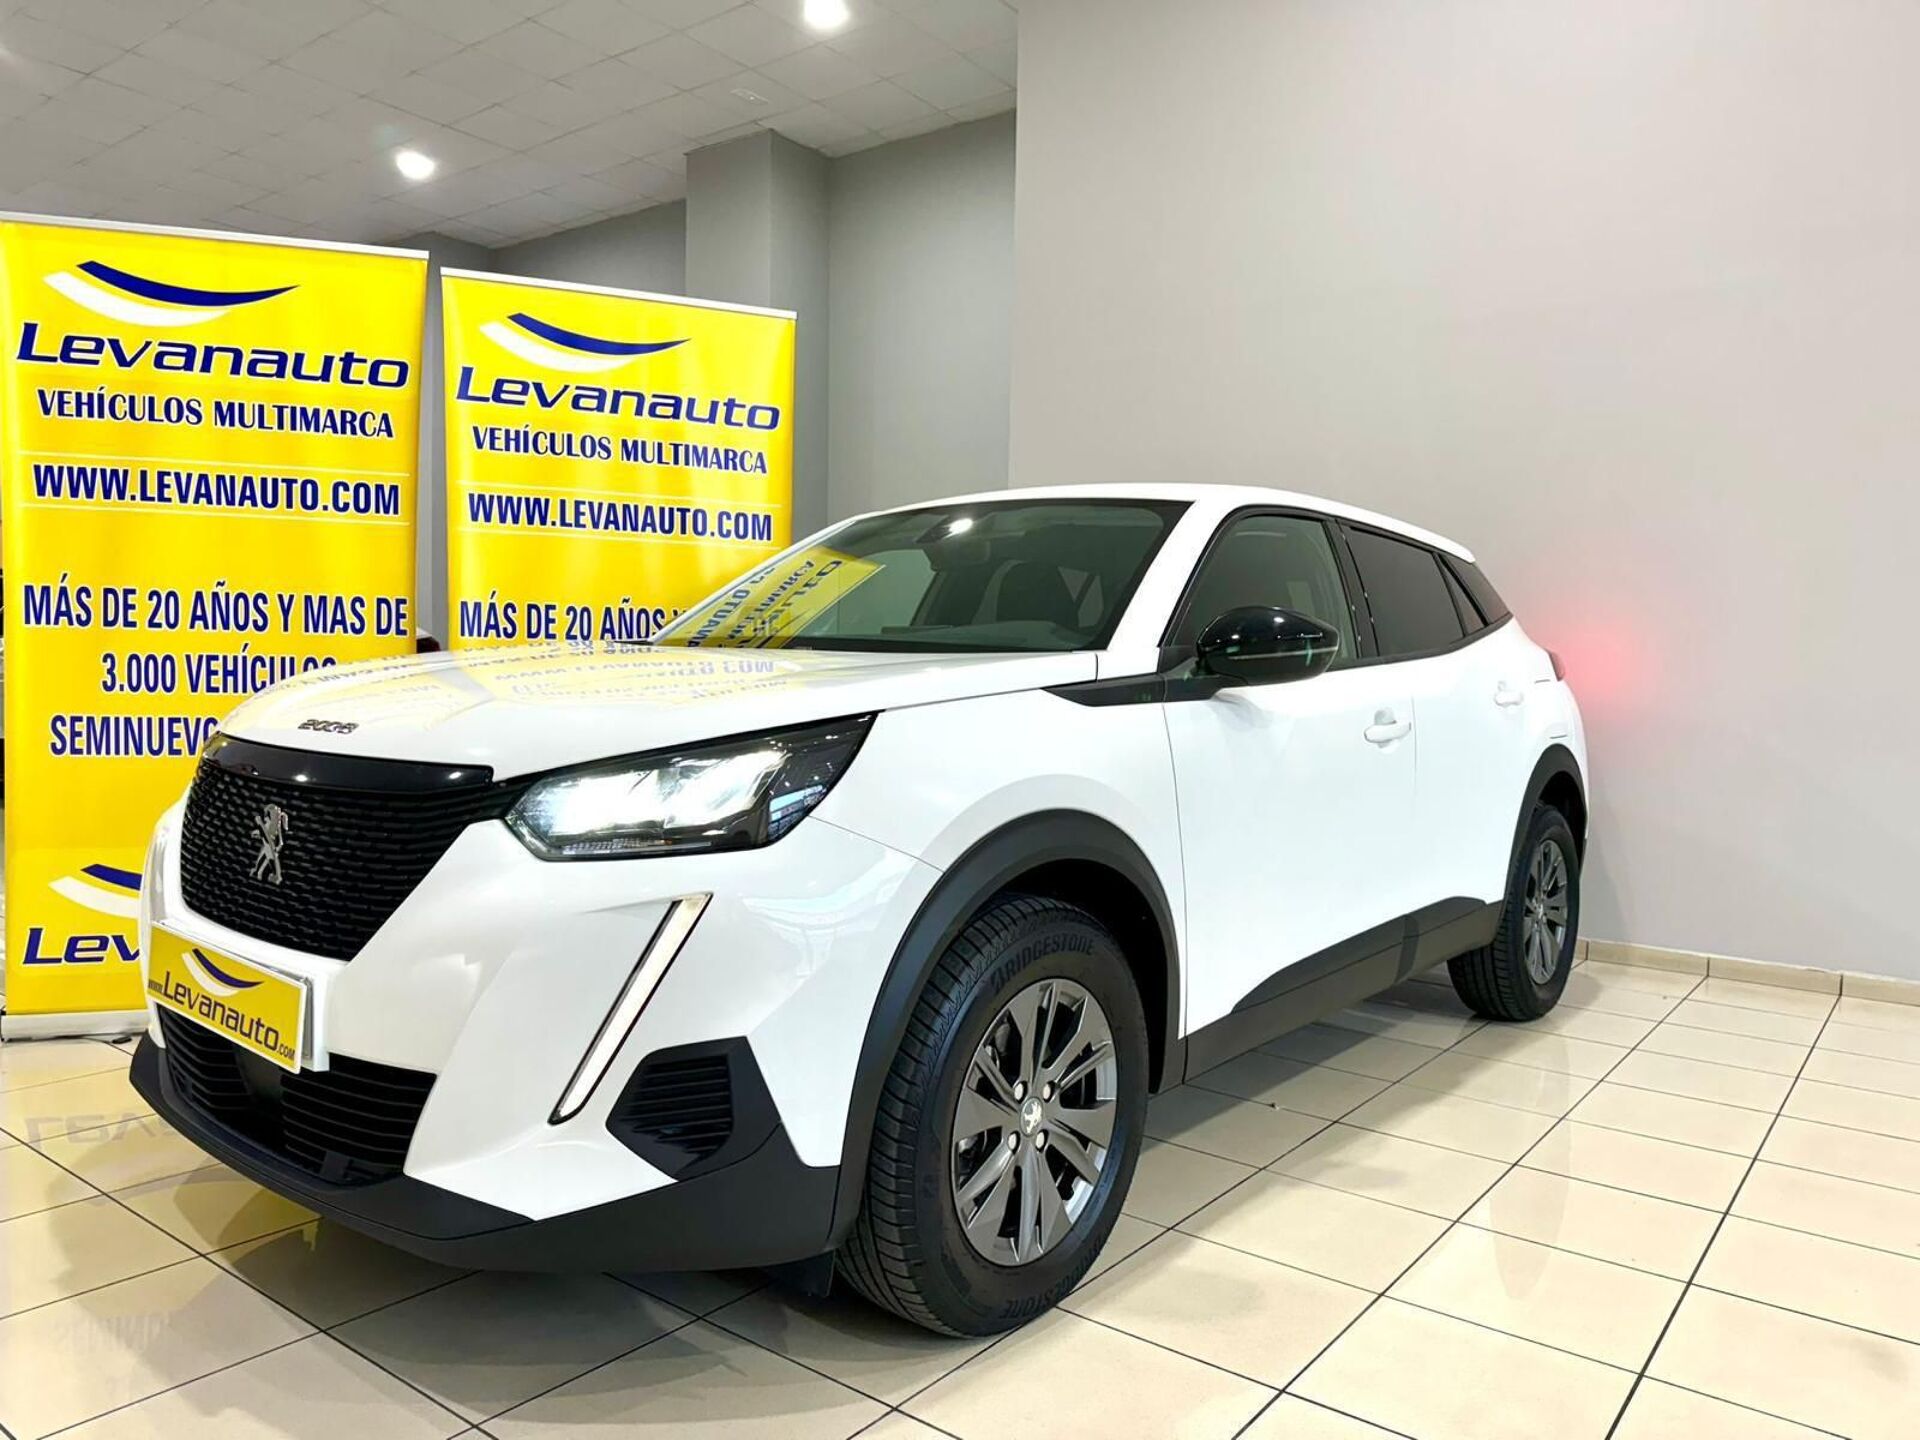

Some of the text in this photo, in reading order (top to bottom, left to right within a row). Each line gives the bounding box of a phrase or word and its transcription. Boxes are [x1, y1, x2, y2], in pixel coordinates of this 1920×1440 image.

[16, 322, 410, 389] Levanauto
[37, 386, 394, 438] VEHÍCULOS MULTIMARCA
[456, 366, 780, 431] Levanauto
[472, 424, 767, 474] VEHÍCULOS MULTIMARCA
[33, 464, 400, 515] WWW.LEVANAUTO.COM
[468, 493, 772, 541] WWW.LEVANAUTO.COM
[23, 573, 408, 636] MÁS DE 20 AÑOS Y MAS DE
[460, 590, 517, 639] MÁS
[526, 603, 557, 640] DE
[565, 605, 592, 641] 20
[599, 598, 666, 640] AÑOS
[102, 653, 176, 693] 3.000
